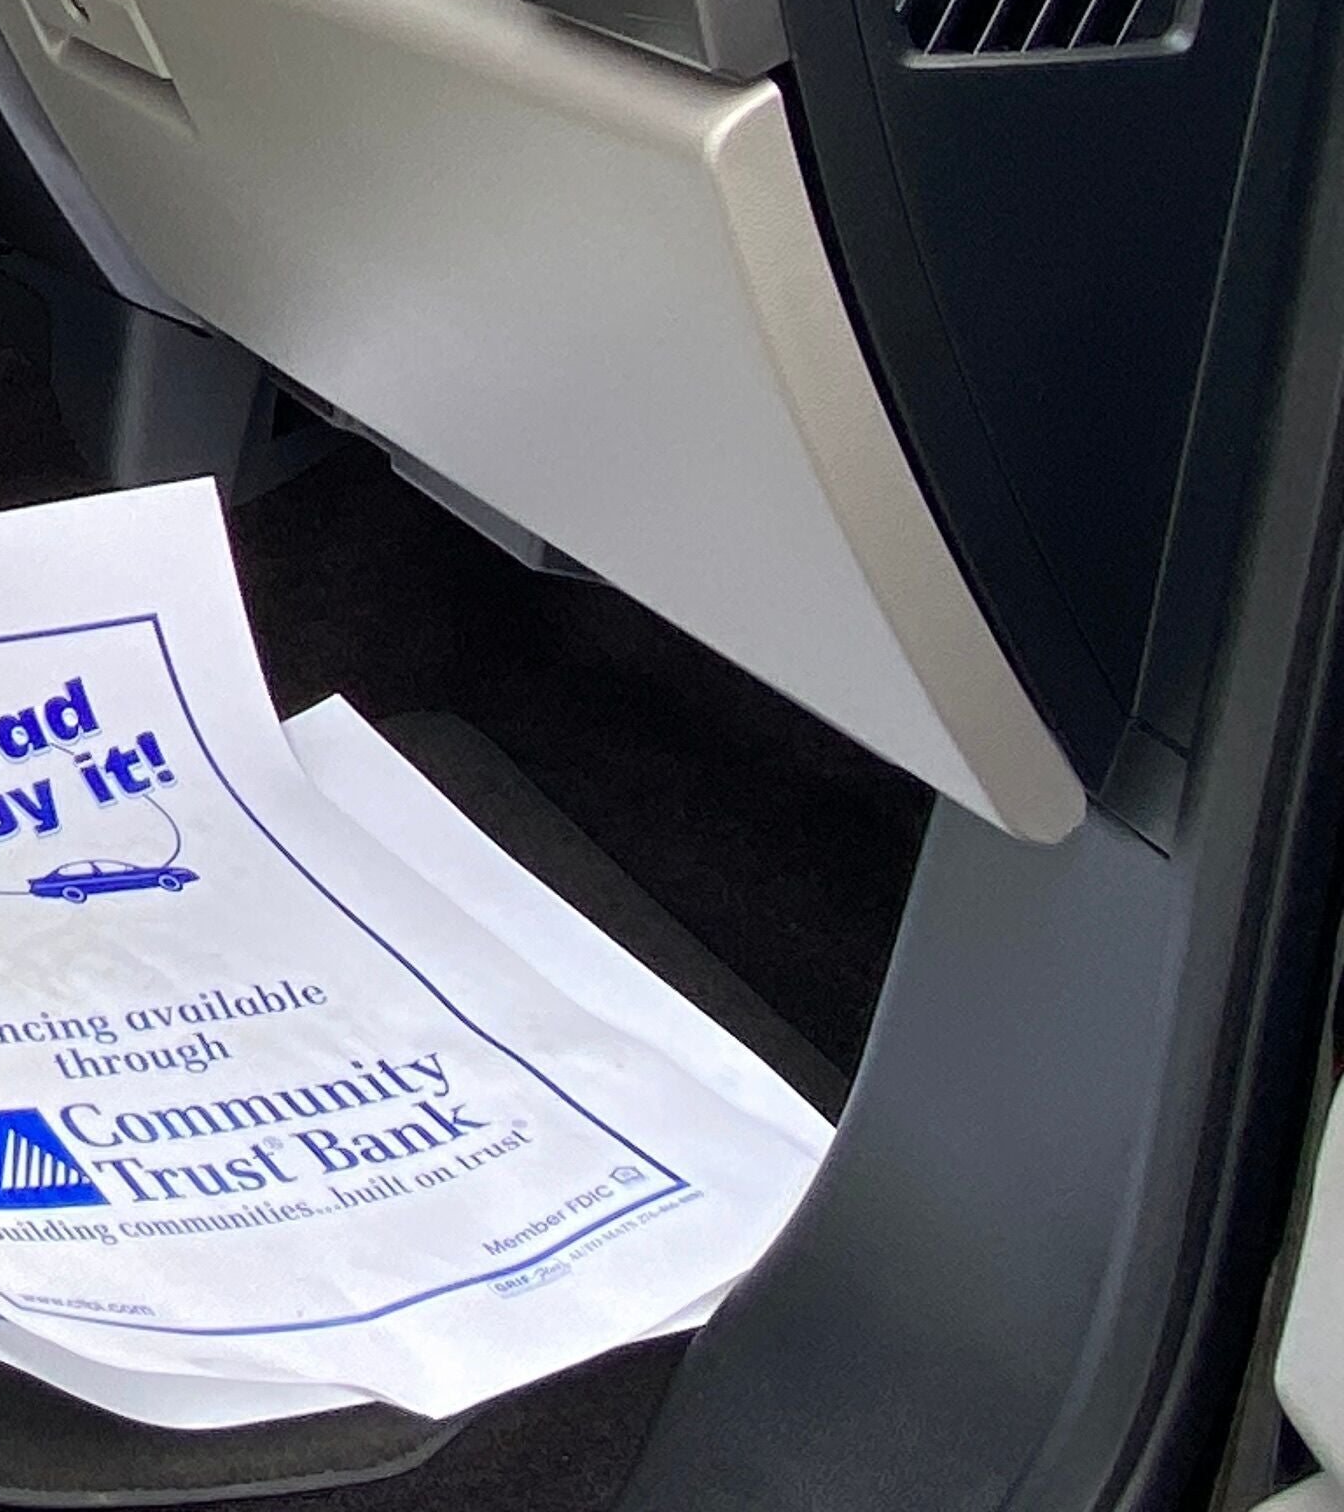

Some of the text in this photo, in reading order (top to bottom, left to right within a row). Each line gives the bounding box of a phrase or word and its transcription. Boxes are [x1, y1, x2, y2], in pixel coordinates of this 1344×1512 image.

[73, 731, 176, 806] it!
[127, 979, 327, 1033] available
[54, 1034, 232, 1082] through
[60, 1049, 452, 1150] Community
[298, 1098, 488, 1173] Bank
[415, 1165, 456, 1190] on
[482, 1206, 567, 1257] Member
[566, 1184, 614, 1214] FDIC
